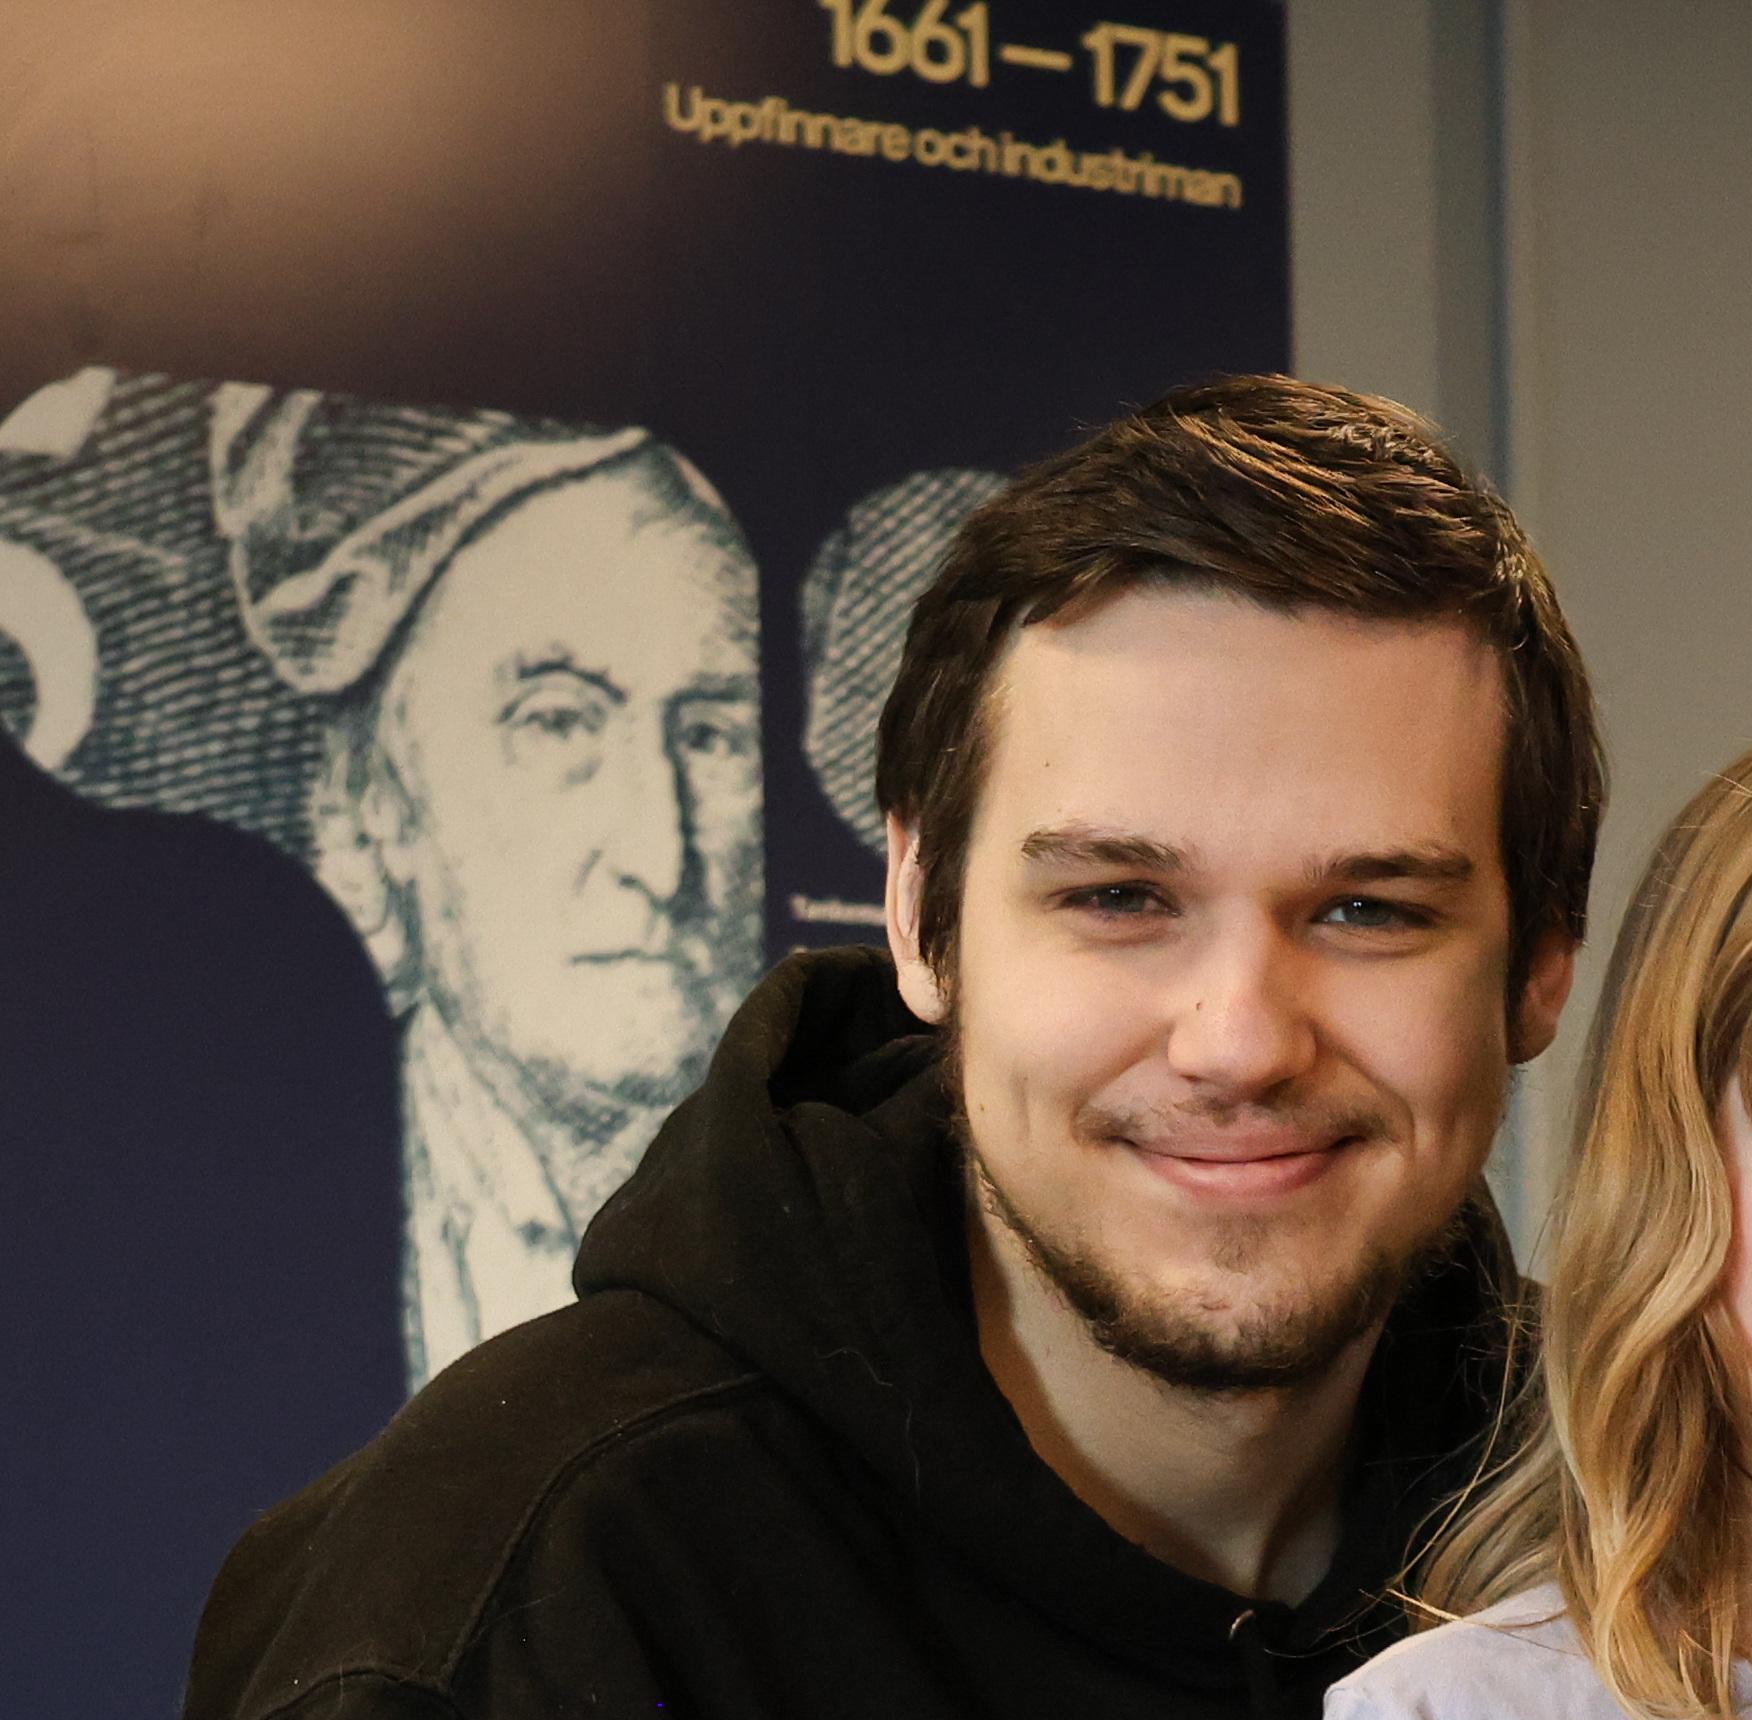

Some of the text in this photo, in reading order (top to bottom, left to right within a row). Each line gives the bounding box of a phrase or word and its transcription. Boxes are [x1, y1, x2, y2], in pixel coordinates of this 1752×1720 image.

[820, 0, 990, 88] 1661
[1081, 21, 1241, 127] 1751
[664, 81, 1243, 209] Uppfinnare och industriman
